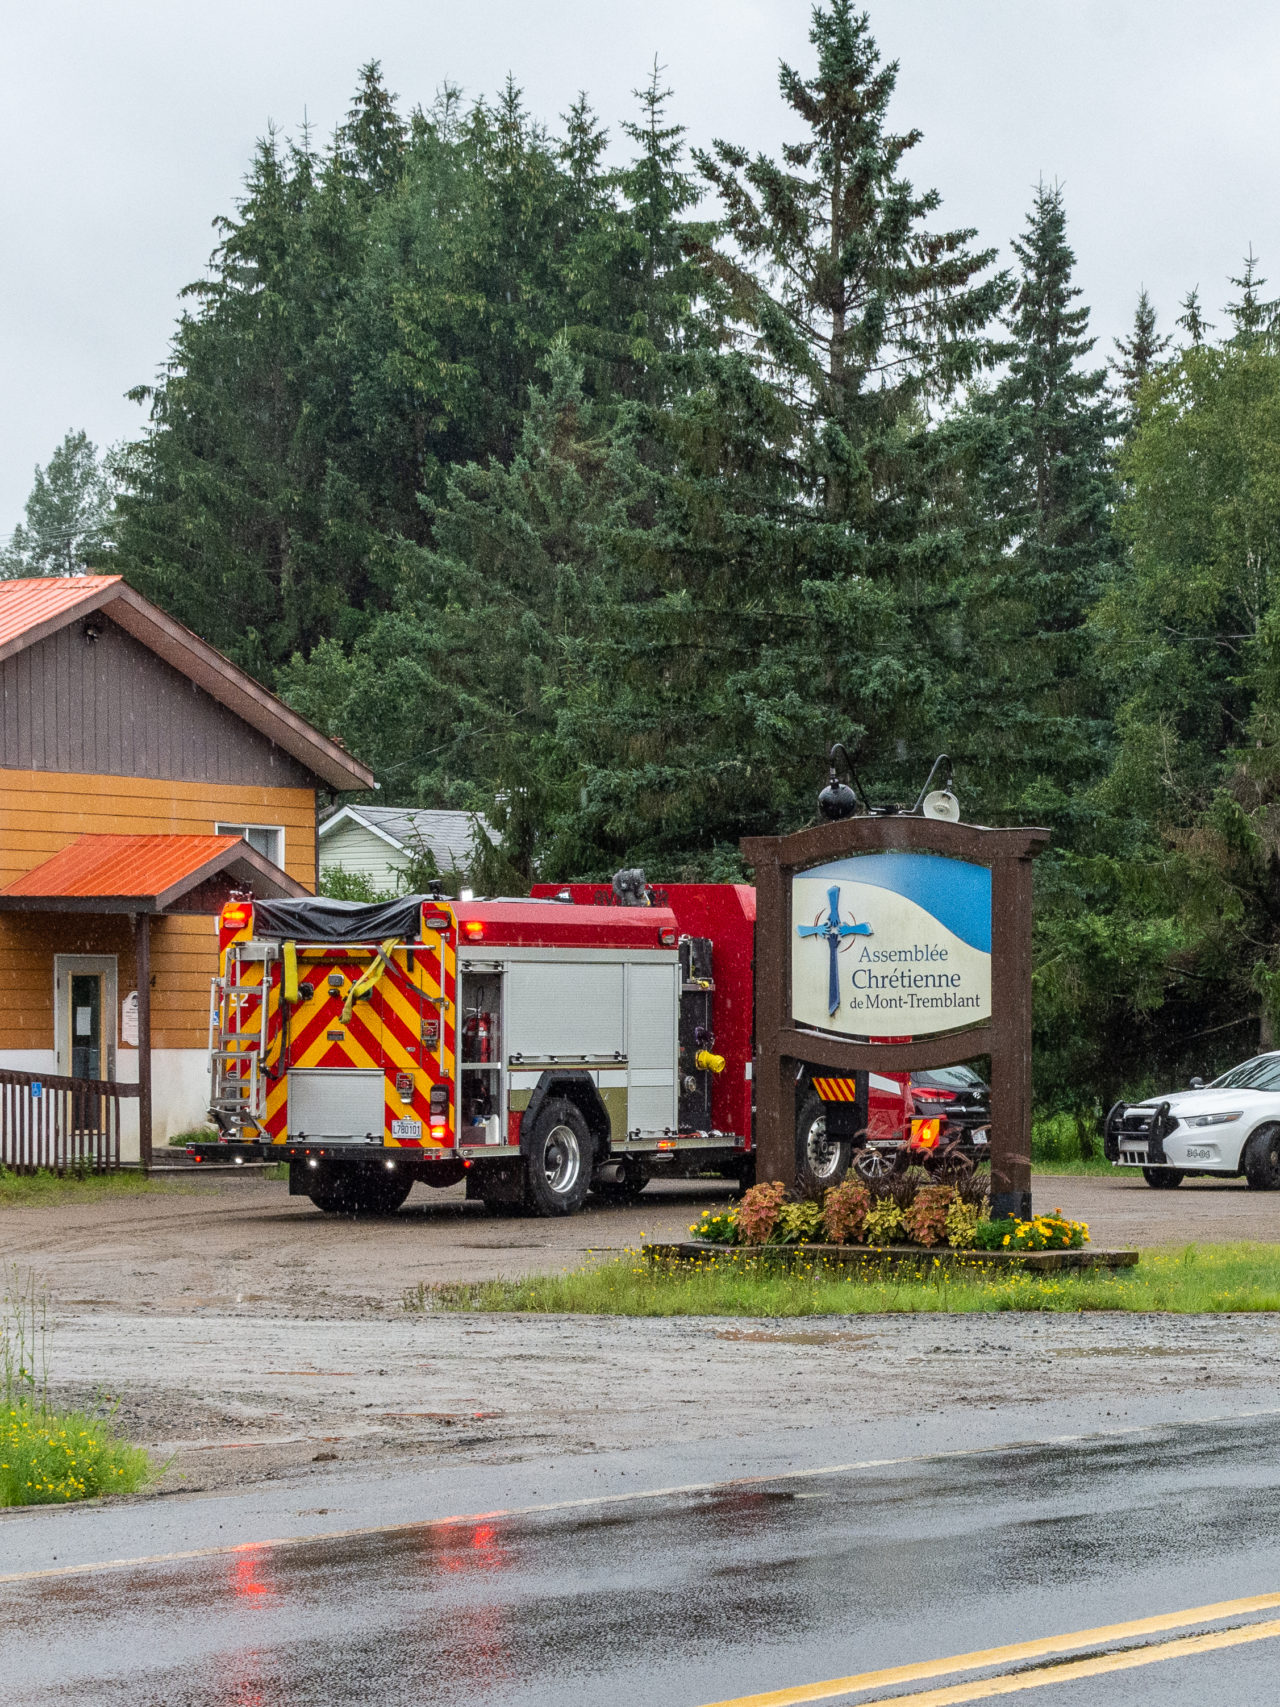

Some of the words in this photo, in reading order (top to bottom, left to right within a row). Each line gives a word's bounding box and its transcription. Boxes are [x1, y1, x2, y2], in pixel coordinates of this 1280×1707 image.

[859, 944, 949, 962] Assemblée
[852, 968, 961, 989] Chrétienne
[850, 997, 864, 1009] de
[866, 993, 981, 1009] Mont-Tremblant
